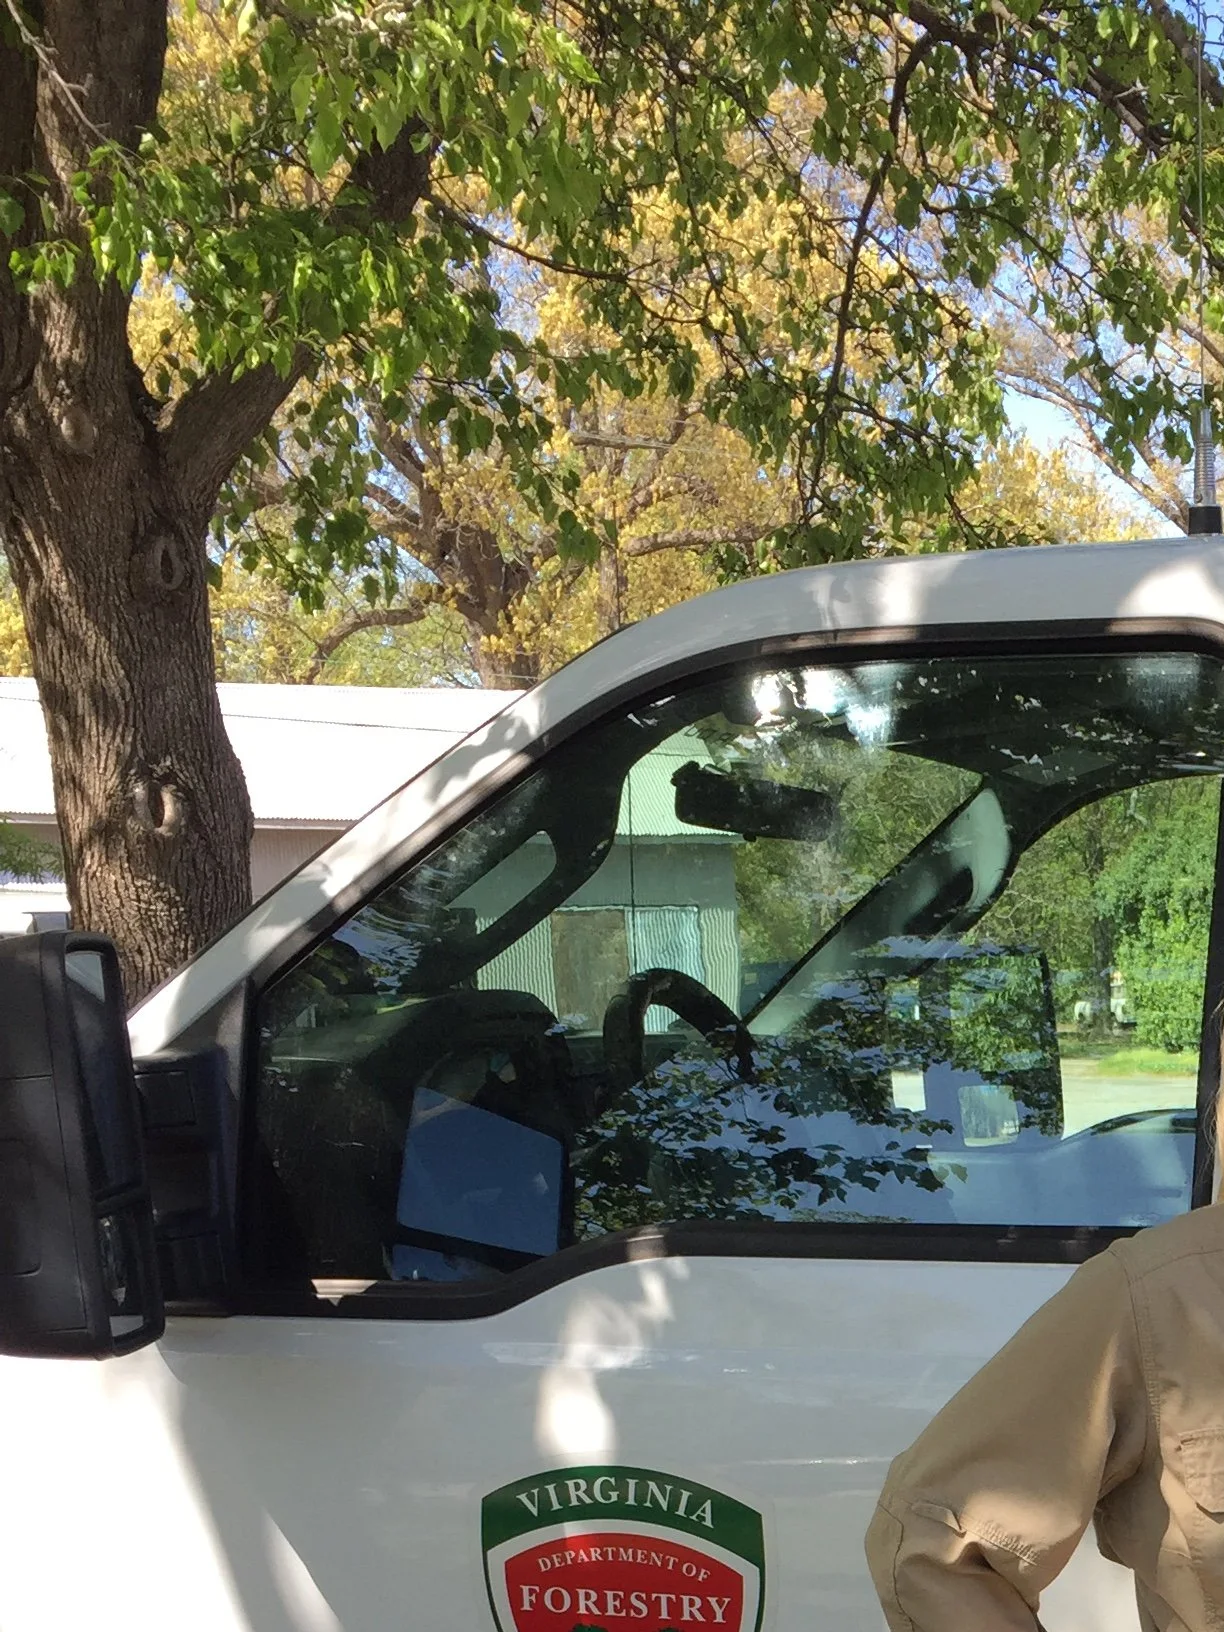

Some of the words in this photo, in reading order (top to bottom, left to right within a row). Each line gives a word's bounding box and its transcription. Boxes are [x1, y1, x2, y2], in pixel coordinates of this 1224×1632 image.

[516, 1476, 715, 1529] VIRGINIA
[537, 1546, 678, 1572] DEPARTMENT
[682, 1562, 711, 1583] OF
[519, 1584, 732, 1623] FORESTRY
